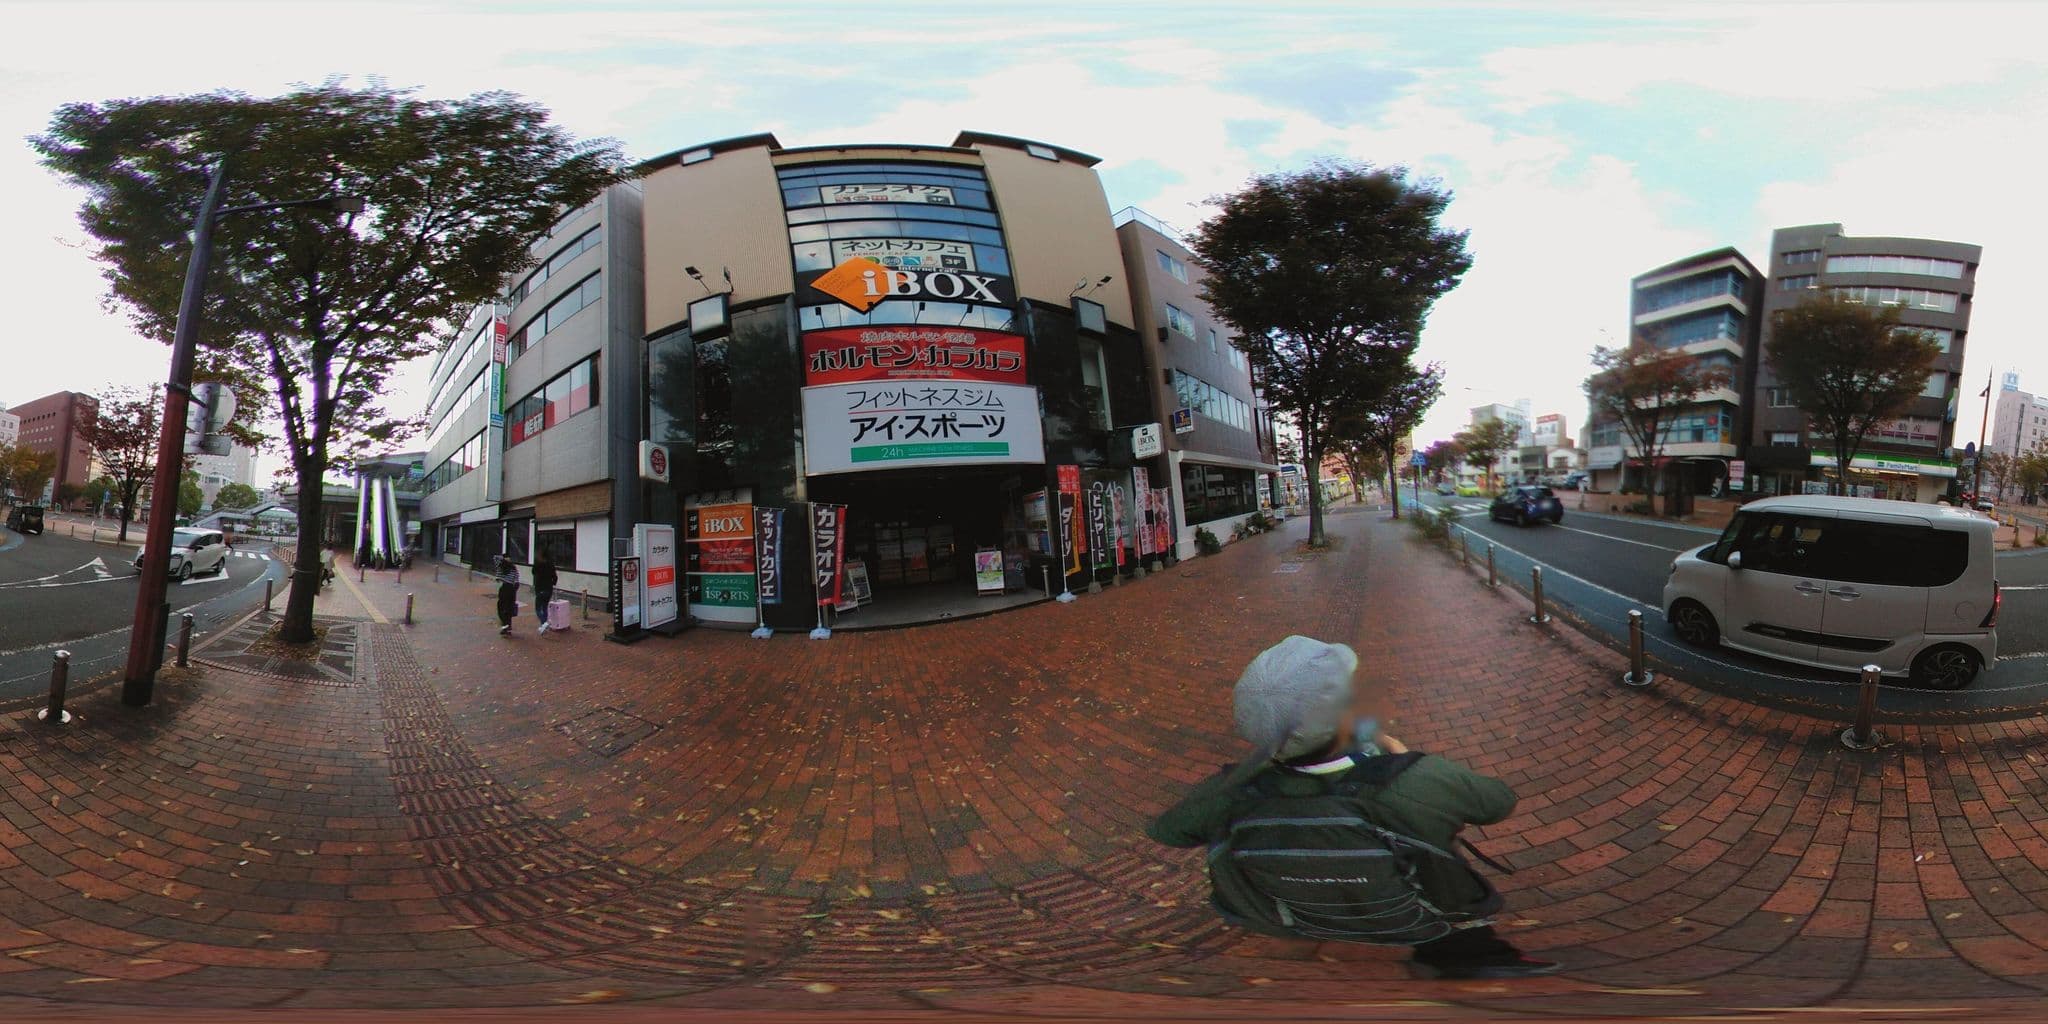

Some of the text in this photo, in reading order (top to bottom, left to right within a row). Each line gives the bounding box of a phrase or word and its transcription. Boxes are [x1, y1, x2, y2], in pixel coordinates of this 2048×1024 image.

[841, 239, 966, 255] ネットカフェ
[863, 269, 1003, 304] iBOX
[846, 387, 1004, 410] フィットネスジム
[850, 412, 1006, 443] アイ・スポーツ
[880, 447, 905, 458] 24h
[1886, 462, 1918, 472] FamilyMart
[704, 516, 745, 533] iBOX
[761, 511, 775, 597] ネットカフェ
[816, 508, 836, 588] カラオケ
